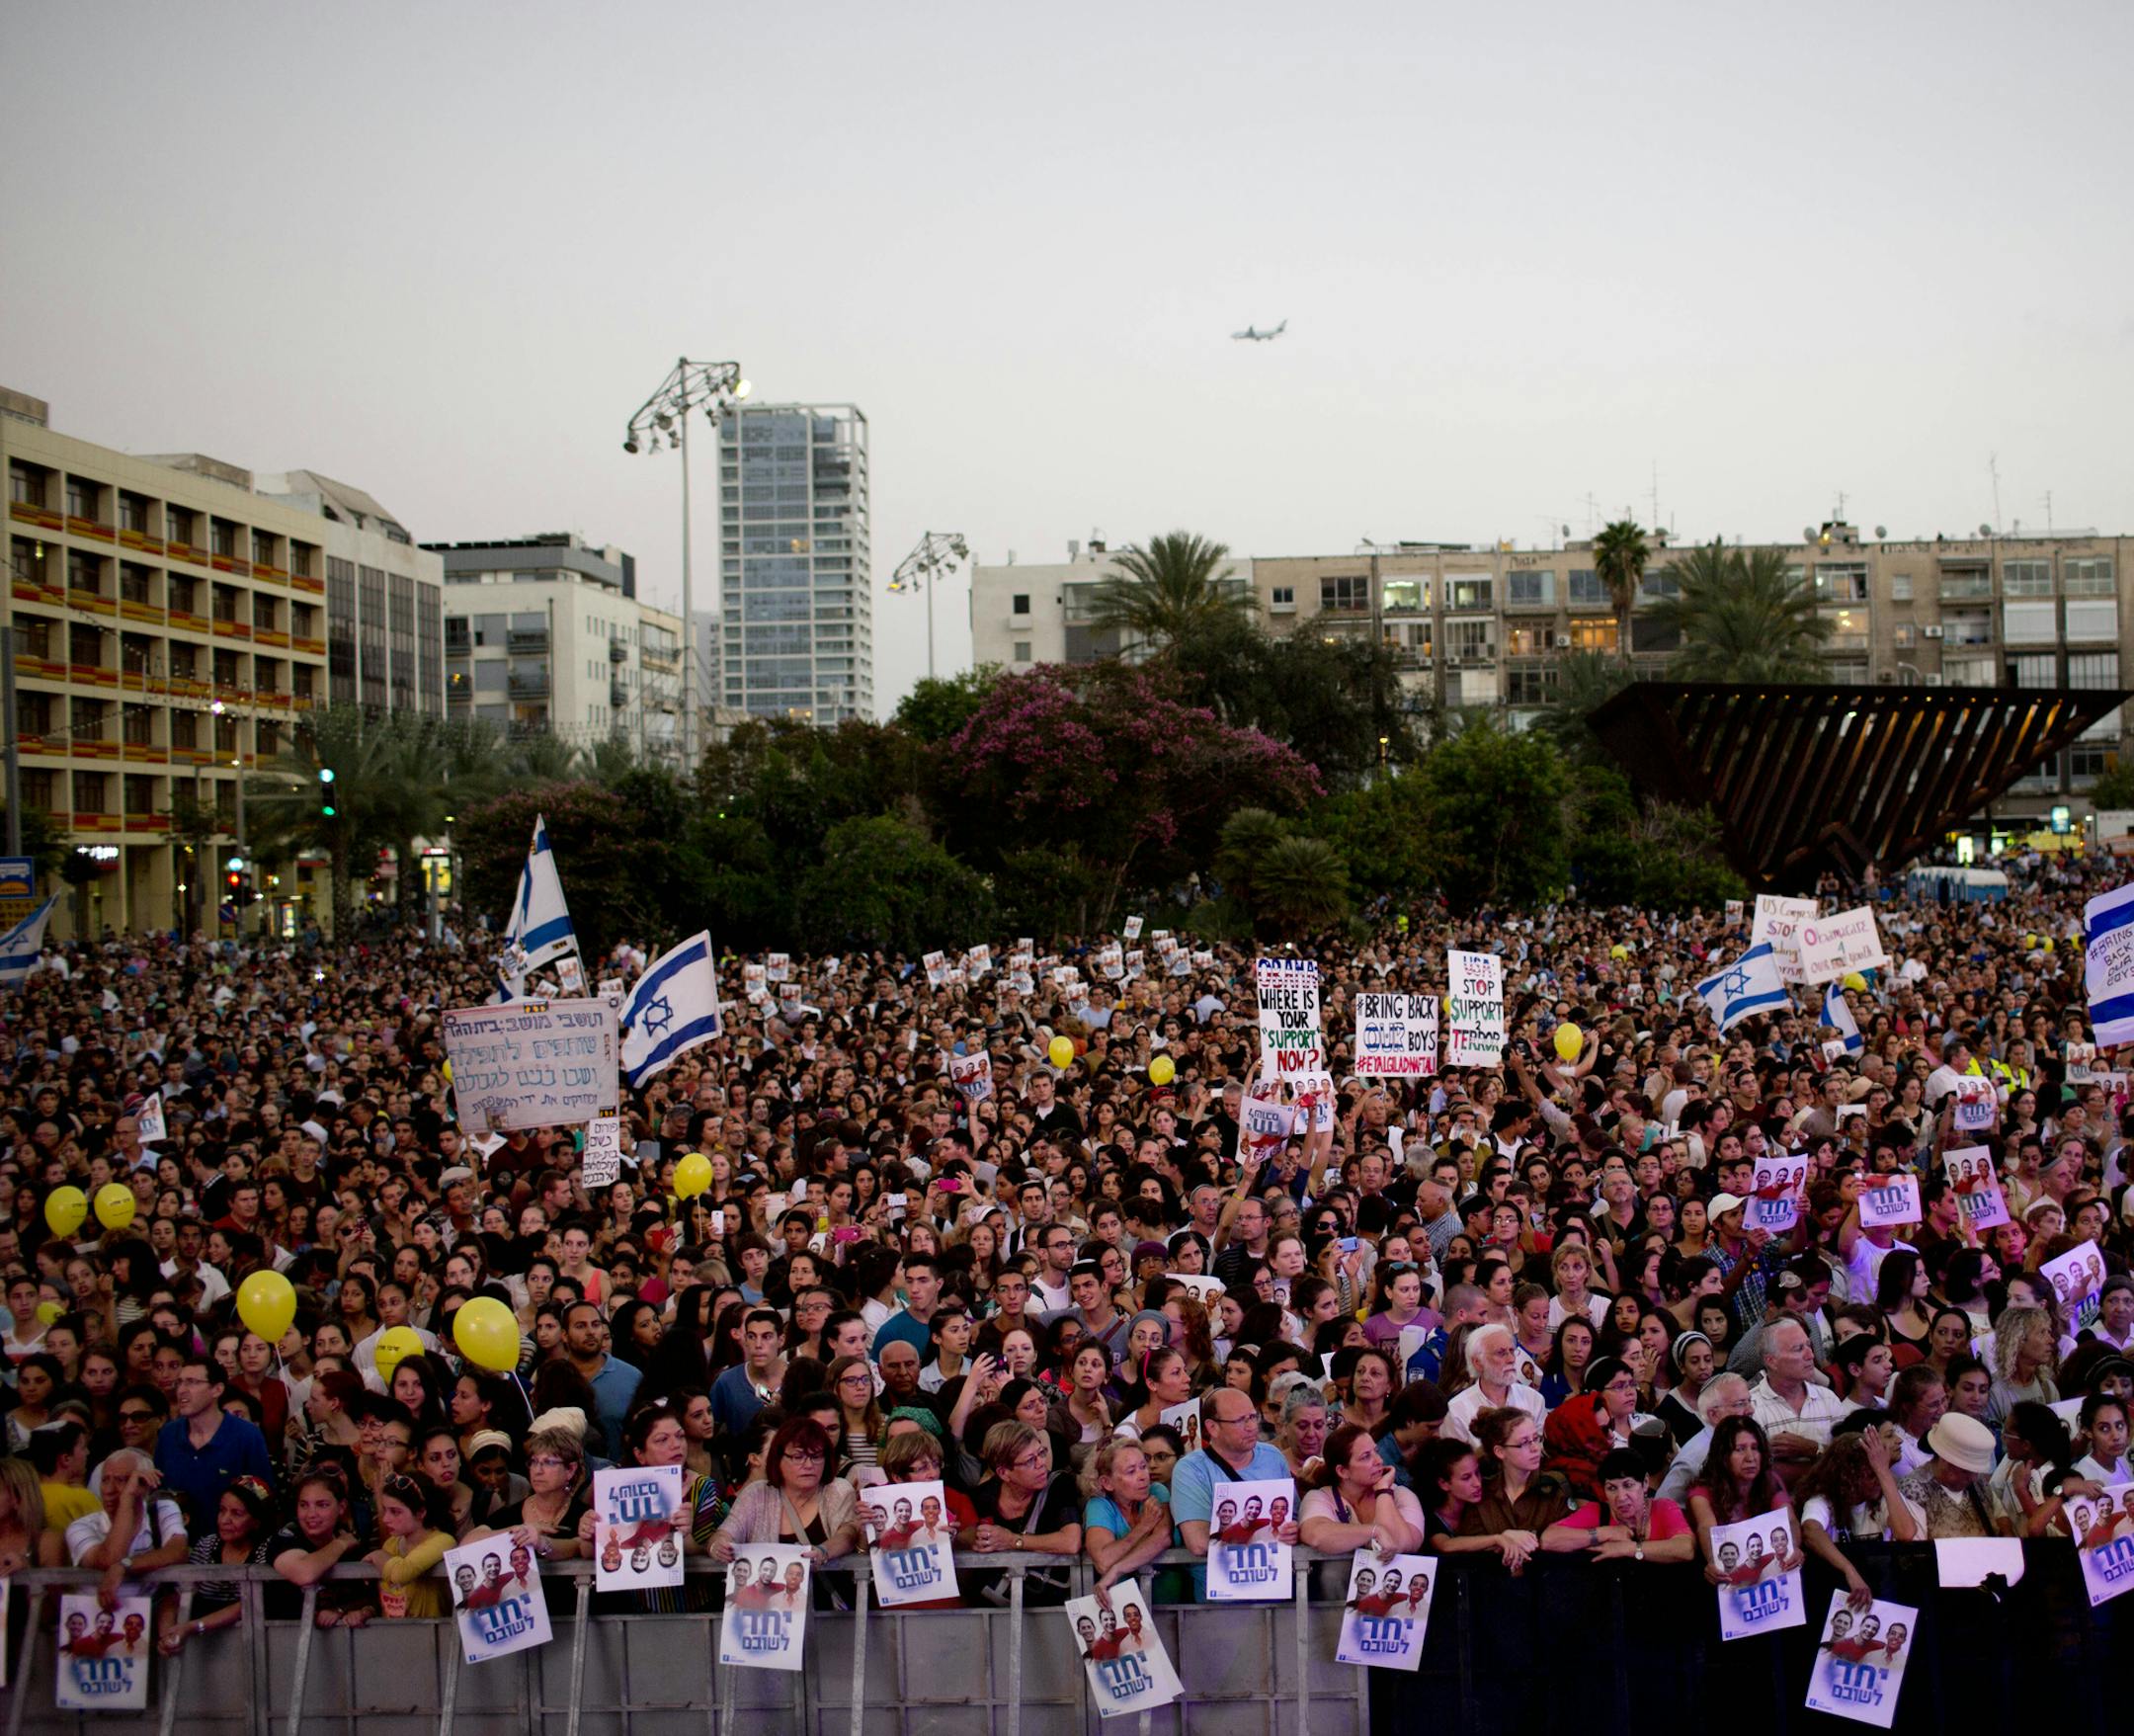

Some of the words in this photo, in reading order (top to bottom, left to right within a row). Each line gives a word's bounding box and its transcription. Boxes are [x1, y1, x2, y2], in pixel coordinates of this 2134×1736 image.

[2090, 929, 2133, 960] #BRING
[2104, 942, 2132, 966] BACK
[2108, 954, 2132, 976] OUR
[1260, 988, 1298, 1010] WHERE
[1303, 989, 1314, 1010] IS
[1463, 979, 1495, 996] STOP
[1408, 996, 1435, 1020] BACK
[1450, 993, 1503, 1024] $UPPORT
[556, 1012, 603, 1029] תושבי
[1276, 1011, 1309, 1029] YOUR
[1475, 1021, 1481, 1031] 2
[1363, 1022, 1406, 1052] OUR
[1408, 1031, 1436, 1051] BOYS
[1452, 1029, 1500, 1052] TERROR
[1277, 1049, 1319, 1072] NOW?
[541, 1093, 557, 1106] את
[1872, 1184, 1909, 1204] יחד
[1961, 1190, 1993, 1211] יחד
[1762, 1199, 1796, 1215] יחד
[609, 1482, 659, 1502] לשובם
[609, 1497, 663, 1525] יחד
[889, 1543, 939, 1573] יחד
[1227, 1542, 1277, 1568] יחד
[2095, 1532, 2134, 1566] חד
[896, 1566, 942, 1589] לשובם
[1229, 1565, 1278, 1583] לשובם
[1739, 1574, 1787, 1608] יחד
[477, 1593, 532, 1628] יחד
[1743, 1597, 1789, 1622] לשובם
[485, 1615, 534, 1645] לשובם
[743, 1611, 792, 1635] יחד
[1362, 1617, 1414, 1640] יחד
[742, 1634, 789, 1651] לשובם
[1360, 1639, 1410, 1654] לשובם
[79, 1657, 133, 1680] יחד
[1102, 1650, 1148, 1684] יחד
[1836, 1660, 1889, 1690] יחד
[80, 1678, 132, 1694] לשובם
[1111, 1674, 1153, 1699] לשובם
[1832, 1684, 1883, 1706] לשובם
